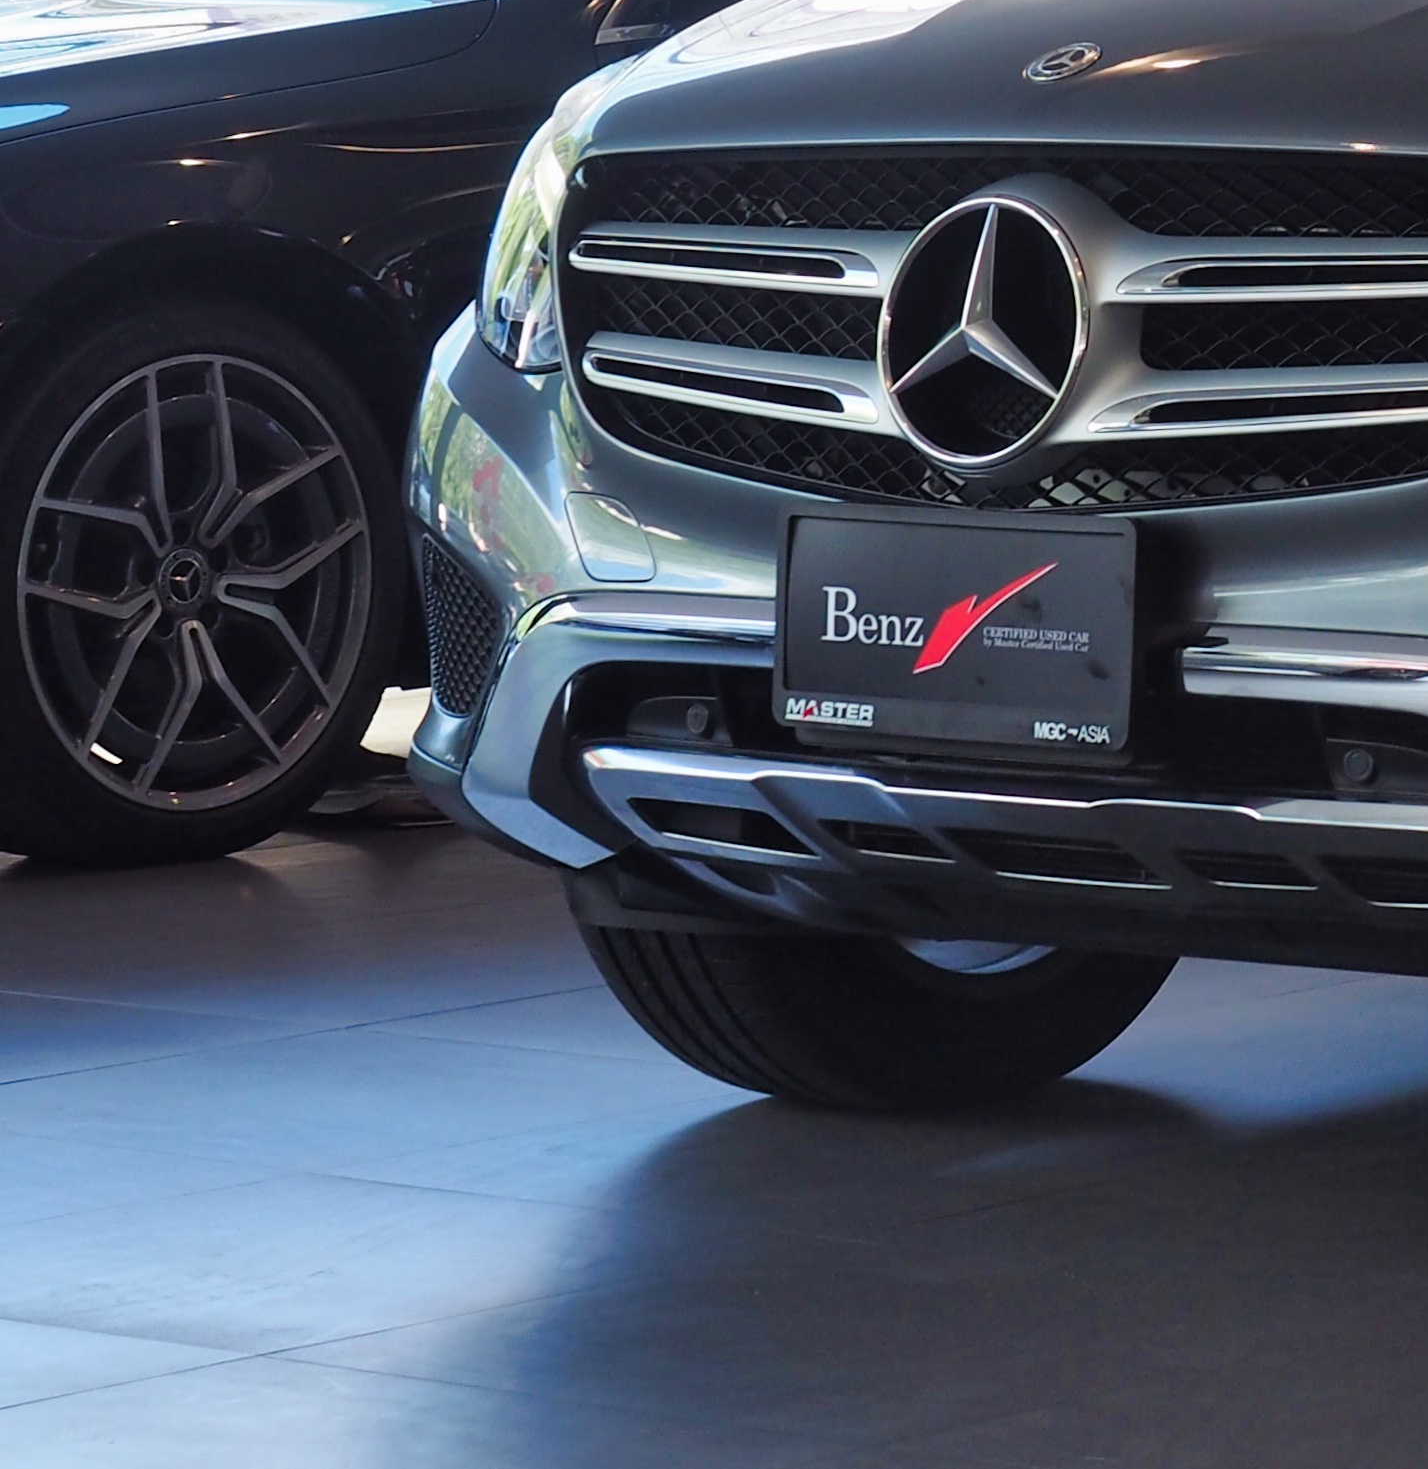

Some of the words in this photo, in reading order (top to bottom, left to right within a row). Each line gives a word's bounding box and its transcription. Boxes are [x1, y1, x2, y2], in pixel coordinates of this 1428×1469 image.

[821, 586, 924, 647] Benz
[983, 626, 1037, 640] CERTIFIED
[1039, 629, 1067, 641] USED
[1068, 631, 1089, 643] CAR
[786, 697, 874, 721] MASTER
